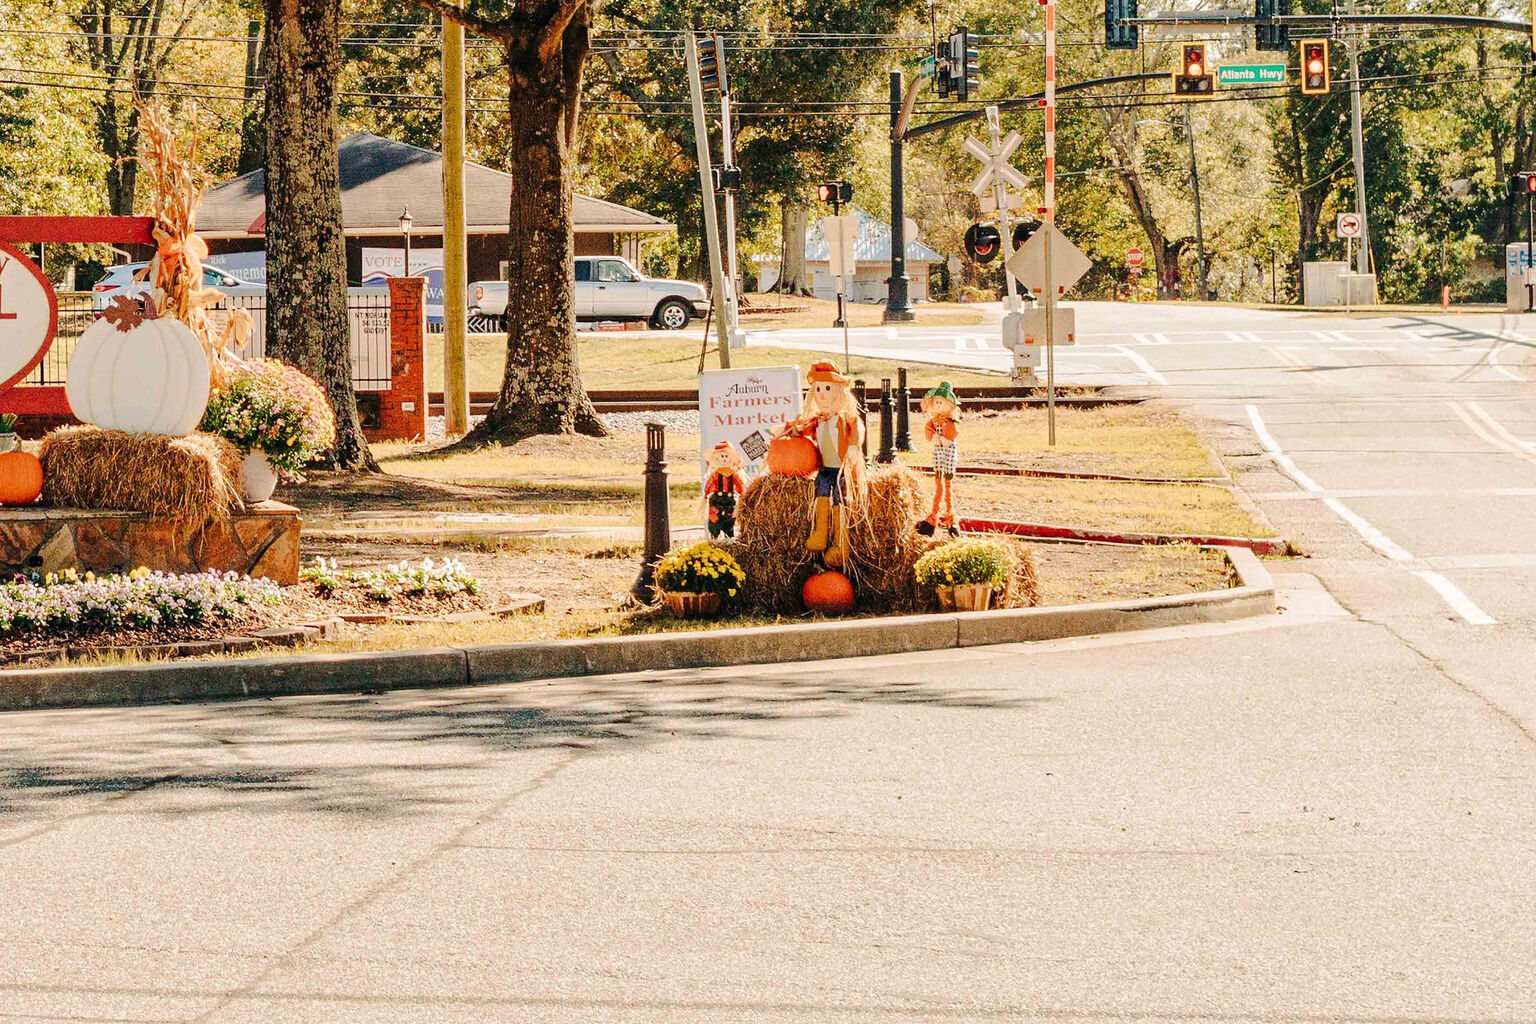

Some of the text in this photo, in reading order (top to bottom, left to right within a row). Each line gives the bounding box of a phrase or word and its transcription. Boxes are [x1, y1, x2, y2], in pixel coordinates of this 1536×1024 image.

[1221, 68, 1283, 80] Atlanta Hwy
[365, 256, 402, 267] VOTE
[1127, 252, 1143, 261] STOP
[725, 383, 769, 397] Auburn
[709, 395, 792, 409] Farmers
[714, 412, 788, 426] Market
